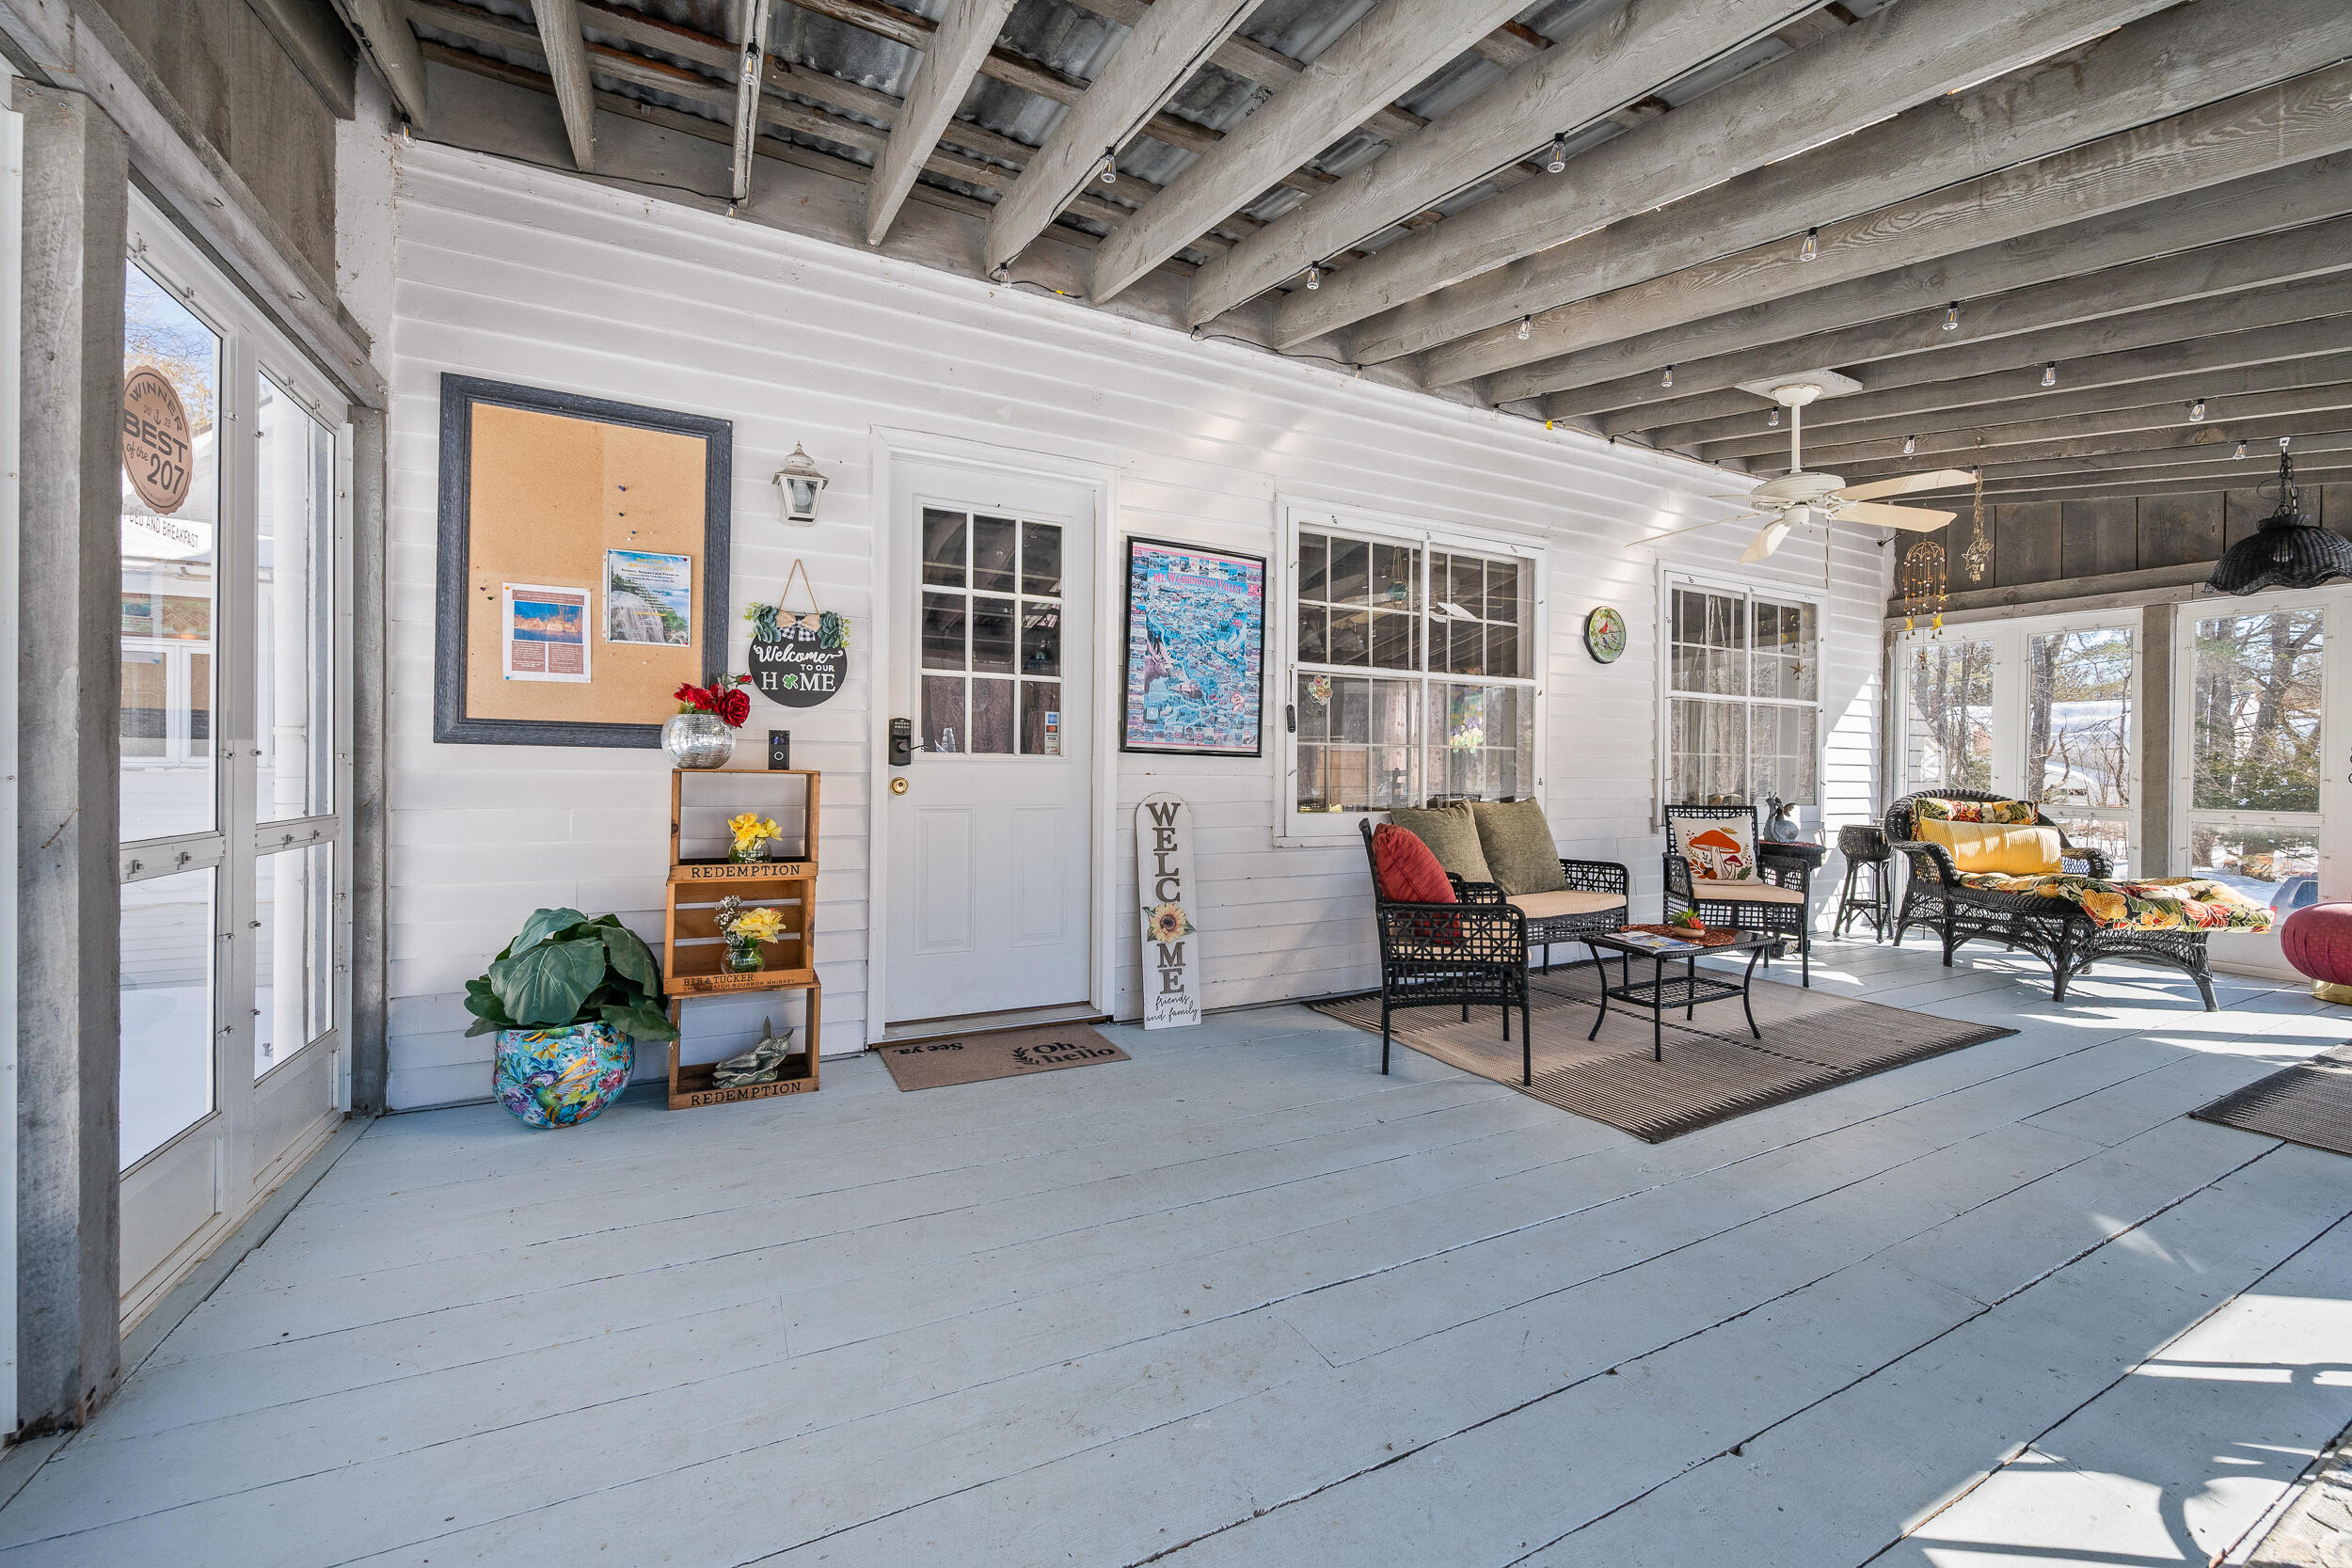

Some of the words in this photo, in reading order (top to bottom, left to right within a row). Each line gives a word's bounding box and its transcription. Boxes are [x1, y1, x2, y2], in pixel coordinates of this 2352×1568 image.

[130, 381, 183, 432] WINNER
[143, 404, 151, 417] 20
[164, 417, 171, 429] 23
[123, 408, 188, 464] BEST
[126, 442, 136, 459] of
[136, 446, 149, 462] the
[147, 452, 184, 495] 207
[129, 506, 144, 527] BED
[146, 514, 161, 533] AND
[162, 520, 199, 549] BREAKFAST
[1217, 578, 1243, 594] VALLEY
[754, 643, 844, 664] Welcome
[816, 664, 834, 673] OUR
[761, 672, 835, 692] HME
[691, 864, 802, 879] REDEMPTION
[1145, 802, 1186, 995] WELCME
[713, 974, 754, 984] TUCKER
[1145, 1009, 1167, 1022] and
[1168, 1000, 1199, 1023] family
[1155, 993, 1190, 1011] friends
[927, 1042, 963, 1053] See
[1039, 1048, 1115, 1064] hello
[691, 1083, 802, 1107] REDEMPTION
